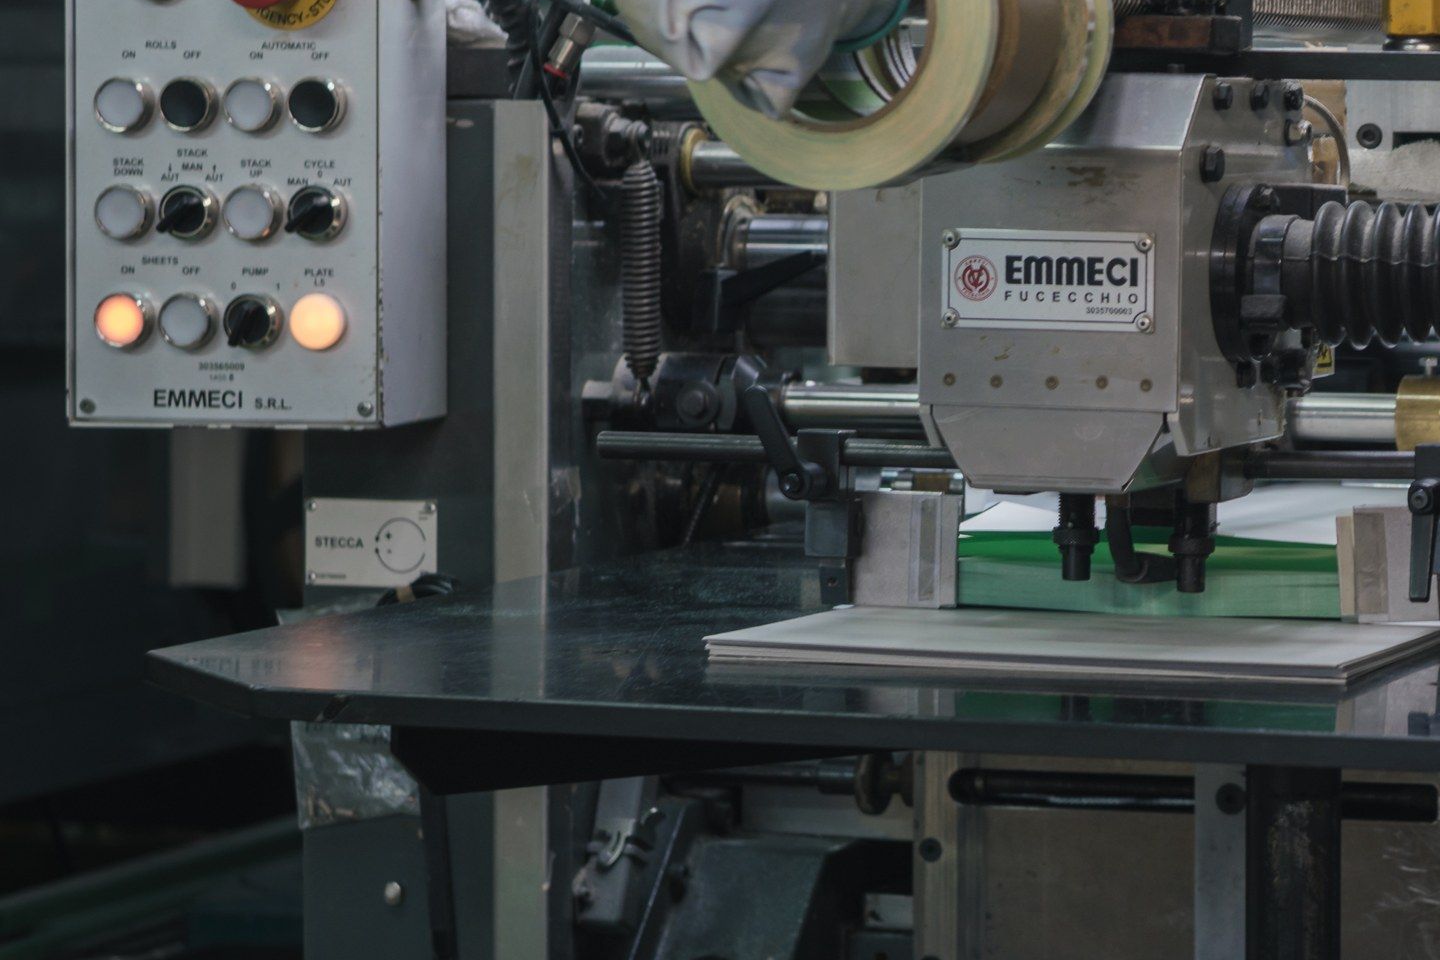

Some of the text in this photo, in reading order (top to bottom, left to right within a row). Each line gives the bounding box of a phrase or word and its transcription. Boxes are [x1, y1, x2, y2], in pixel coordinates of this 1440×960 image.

[145, 40, 177, 50] ROLLS
[261, 41, 317, 51] AUTOMATIC
[121, 50, 202, 60] ON OFF
[249, 51, 330, 61] ON OFF
[176, 148, 208, 158] STACK
[112, 157, 144, 167] STACK
[181, 162, 203, 172] MAN
[240, 159, 272, 168] STACK
[303, 160, 336, 169] CYCLE
[113, 168, 144, 177] DOWN
[160, 173, 224, 182] AUT AUT
[249, 169, 263, 178] UP
[287, 177, 352, 186] MAN AUT
[141, 255, 179, 266] SHEETS
[120, 265, 200, 276] ON OFF
[241, 266, 269, 276] PUMP
[304, 268, 335, 278] PLATE
[1005, 255, 1139, 287] EMMECI
[1004, 290, 1139, 305] FUCECCHIO
[153, 390, 292, 410] EMMECI S.R.L.
[314, 536, 364, 549] STECCA
